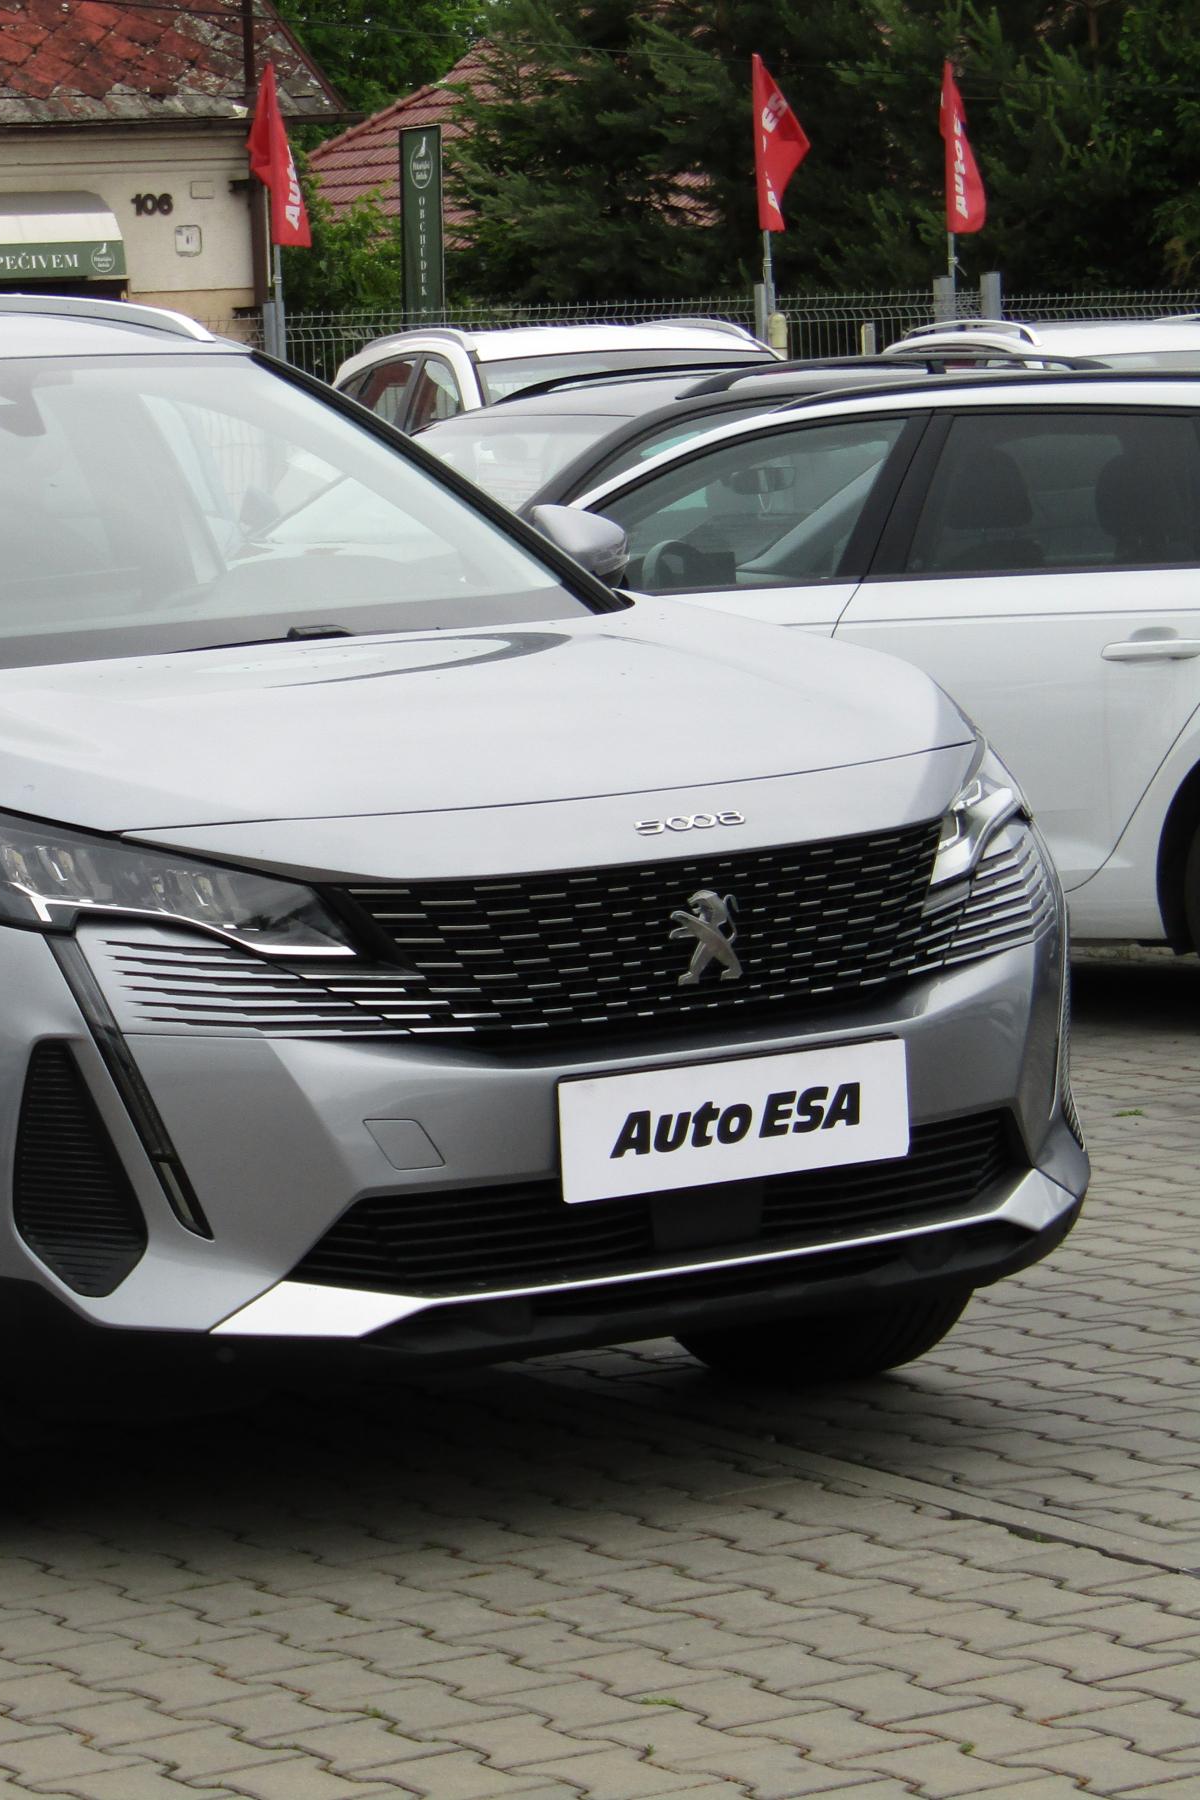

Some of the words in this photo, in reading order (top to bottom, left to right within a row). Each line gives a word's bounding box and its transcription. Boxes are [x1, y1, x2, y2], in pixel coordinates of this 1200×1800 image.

[131, 193, 173, 216] 106
[634, 810, 746, 836] 5008
[609, 1100, 754, 1160] Auto
[758, 1081, 861, 1139] ESA
